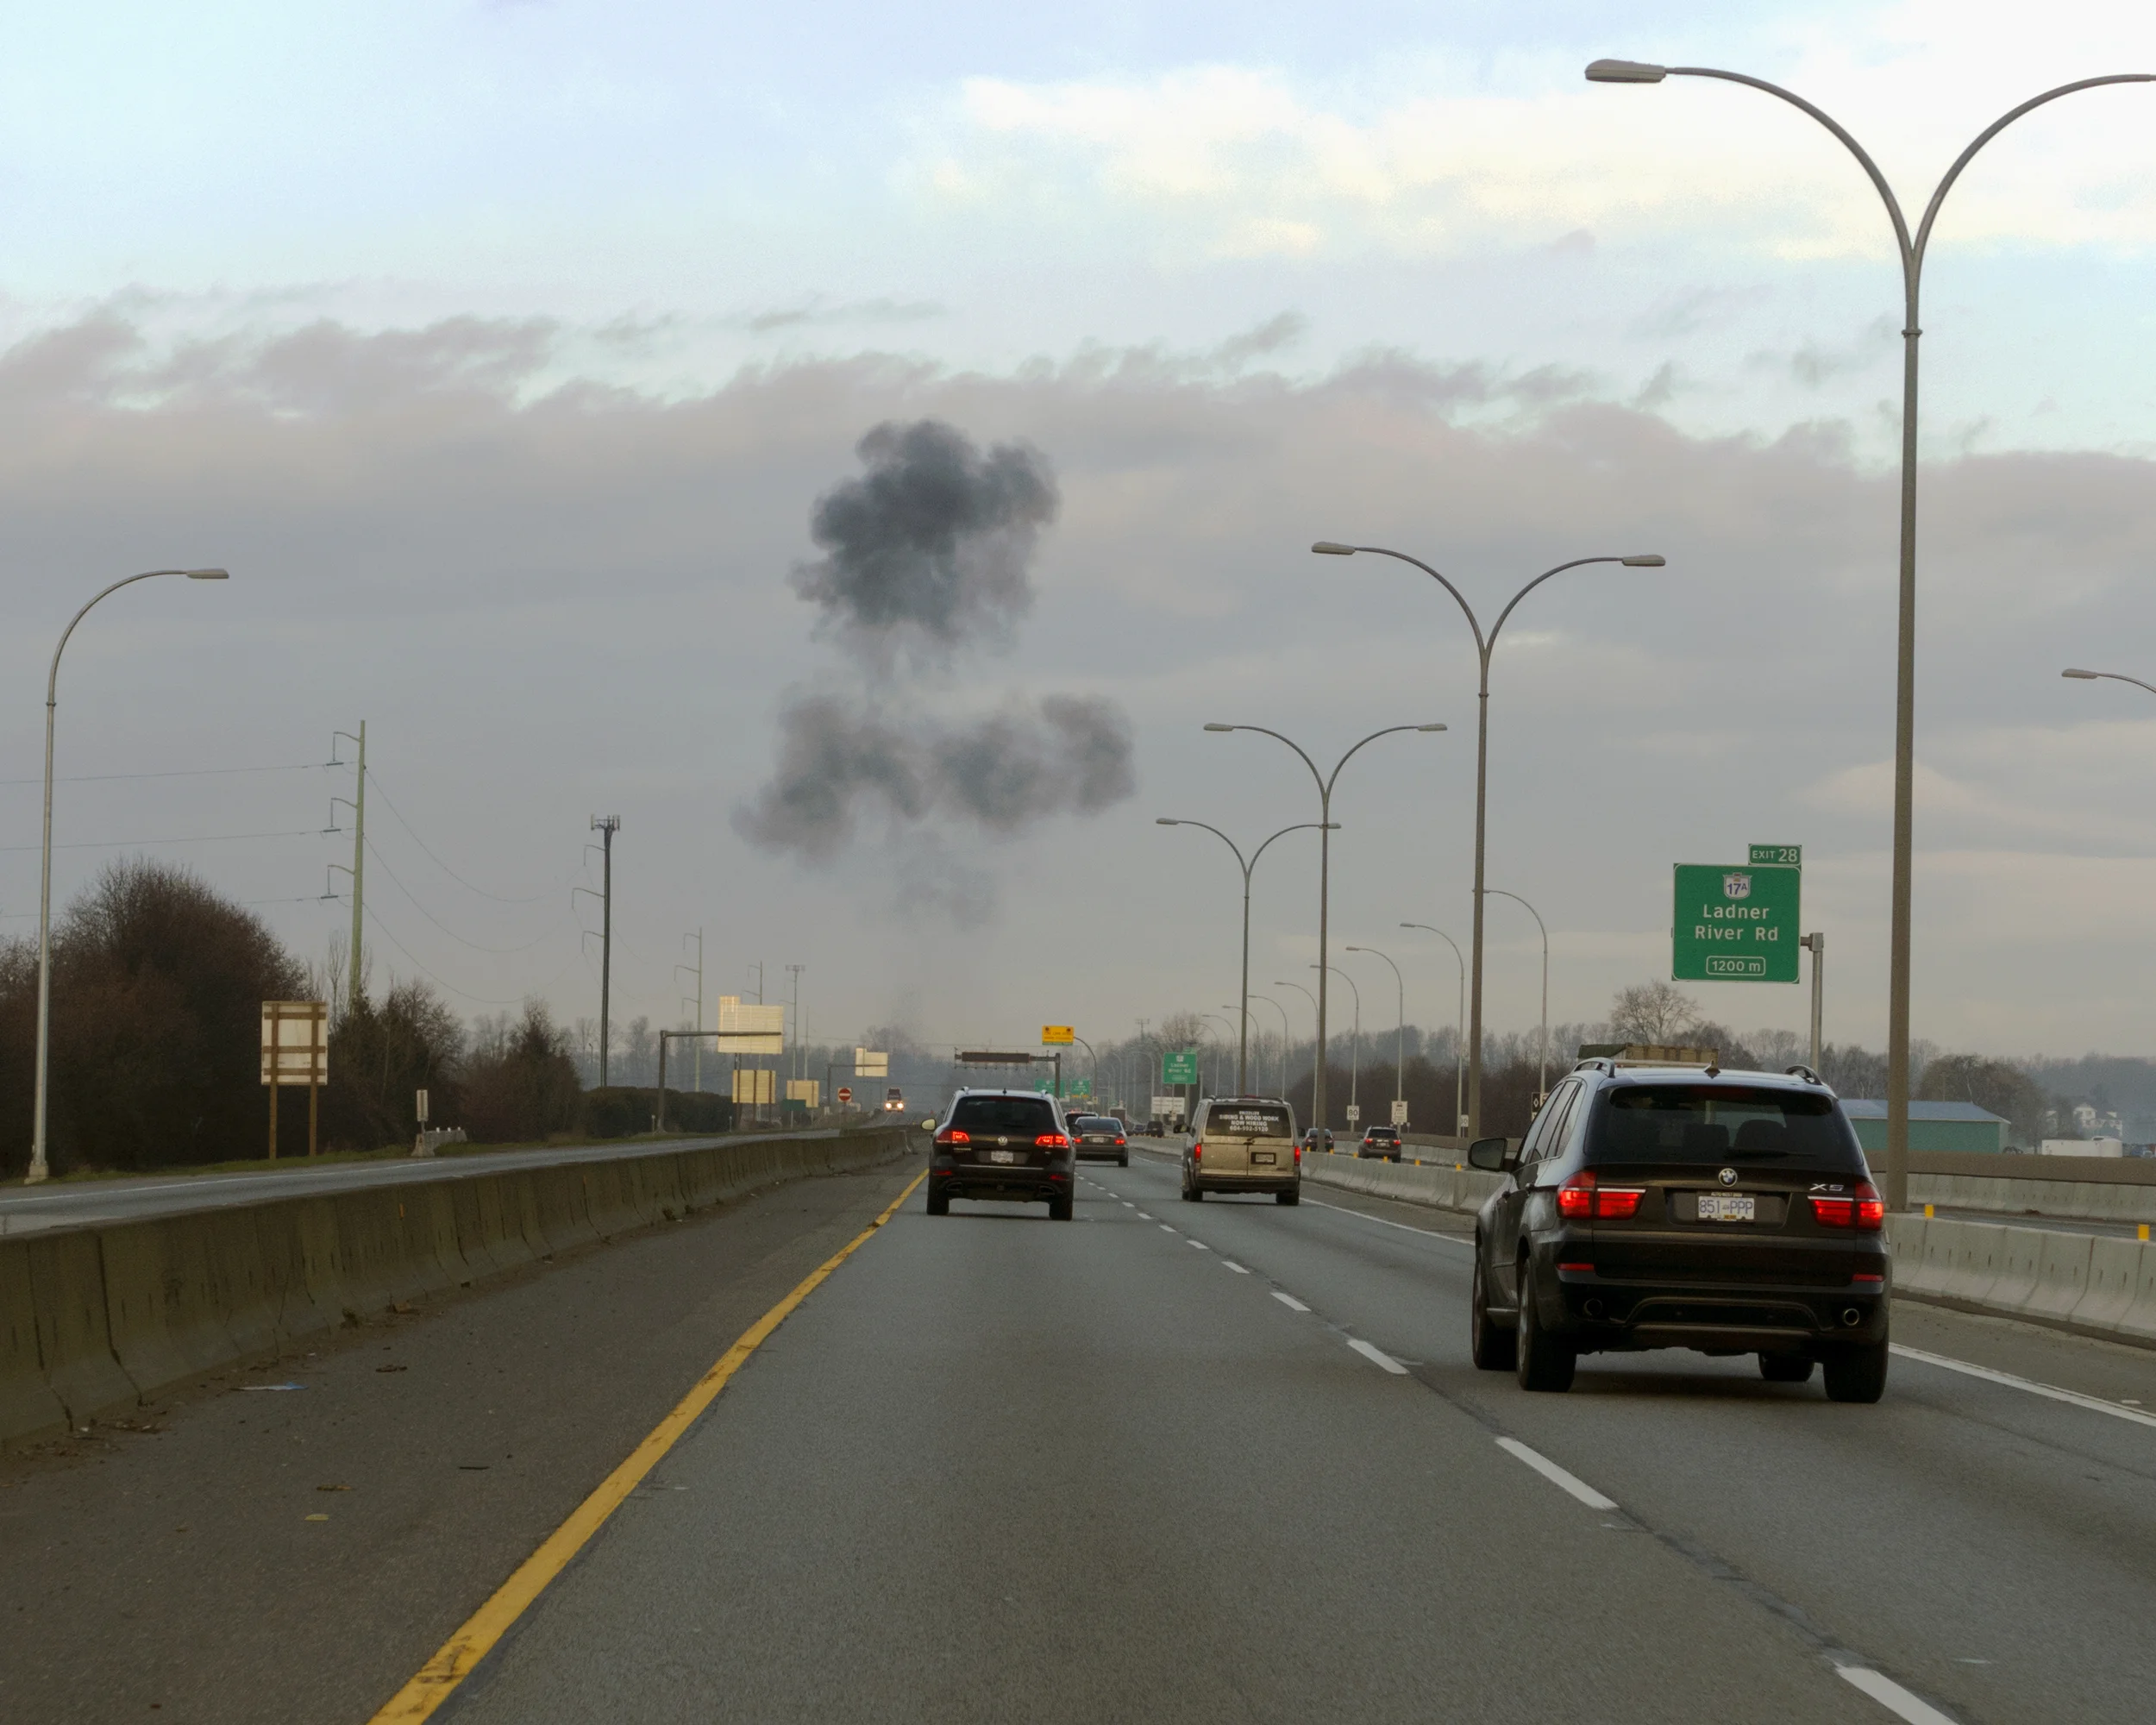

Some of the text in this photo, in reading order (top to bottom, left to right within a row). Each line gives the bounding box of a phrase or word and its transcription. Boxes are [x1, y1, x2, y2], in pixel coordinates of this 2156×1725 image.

[1752, 848, 1798, 862] EXIT 28
[1727, 882, 1748, 895] 17A
[1703, 904, 1770, 919] Ladner
[1695, 924, 1778, 941] River Rd
[1712, 960, 1761, 972] 1200 m
[1809, 1182, 1845, 1192] X5
[1699, 1200, 1753, 1214] 851 PPP
